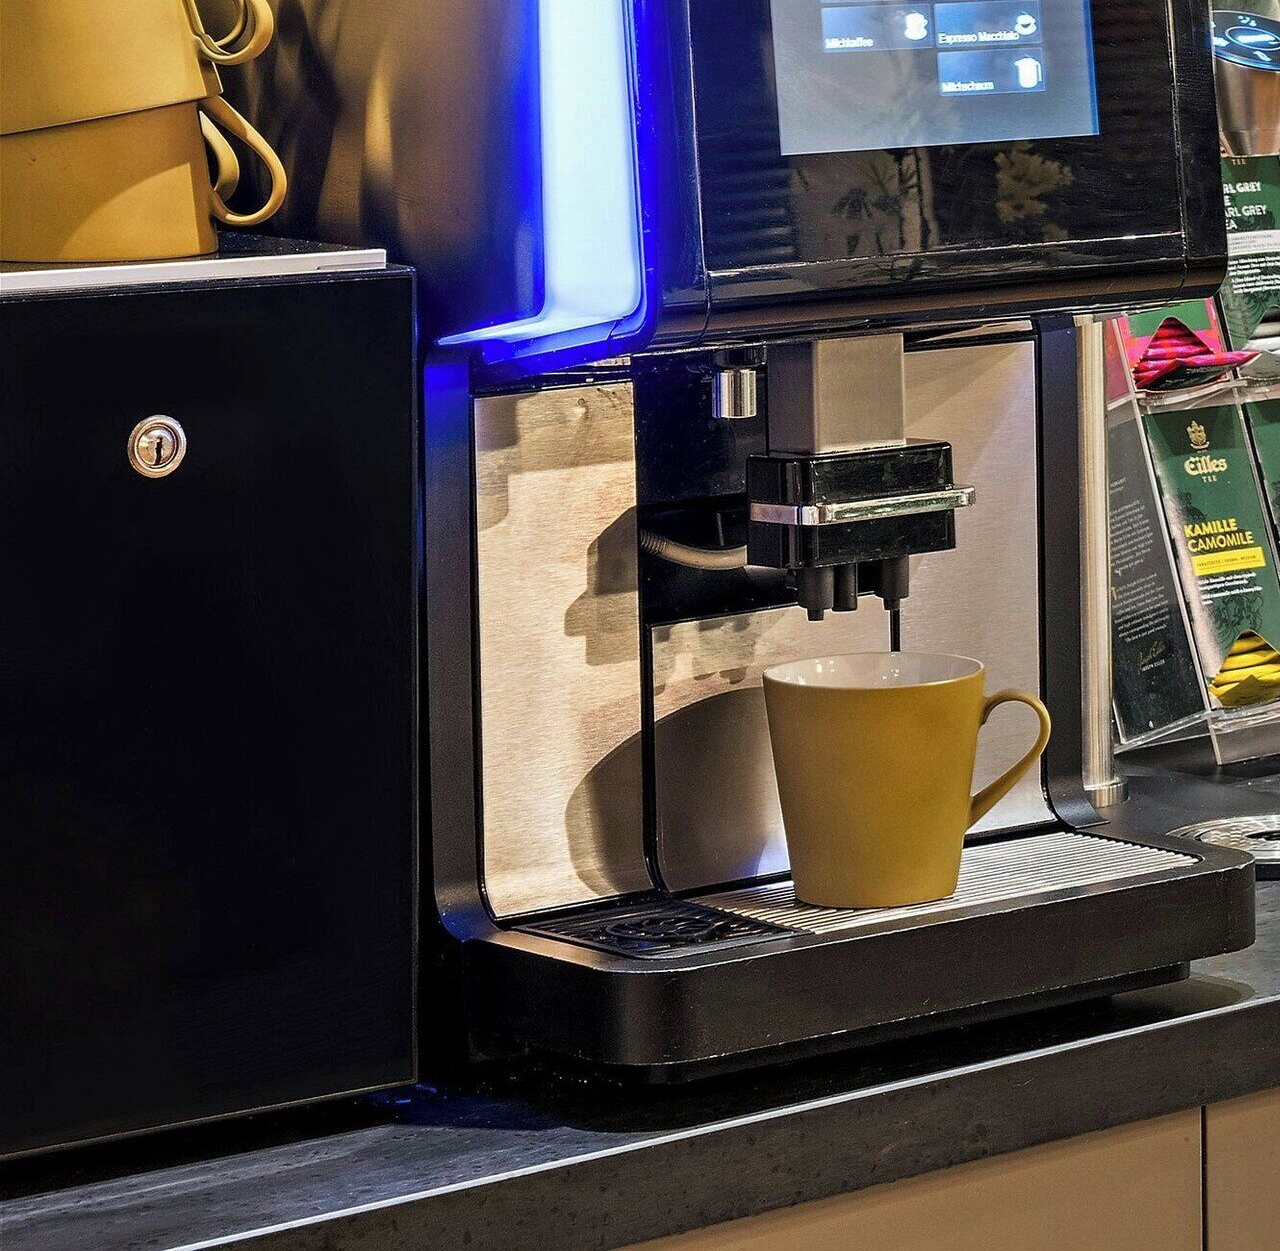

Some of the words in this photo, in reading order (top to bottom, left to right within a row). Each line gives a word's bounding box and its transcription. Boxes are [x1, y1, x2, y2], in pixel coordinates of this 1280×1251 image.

[938, 33, 977, 44] Espresso
[978, 31, 1020, 43] Macchiato
[1236, 181, 1261, 193] GREY
[1242, 204, 1267, 216] GREY
[1184, 455, 1228, 476] Eilles
[1202, 475, 1217, 483] TEE
[1184, 518, 1238, 538] KAMILLE
[1188, 531, 1254, 553] CAMOMILE
